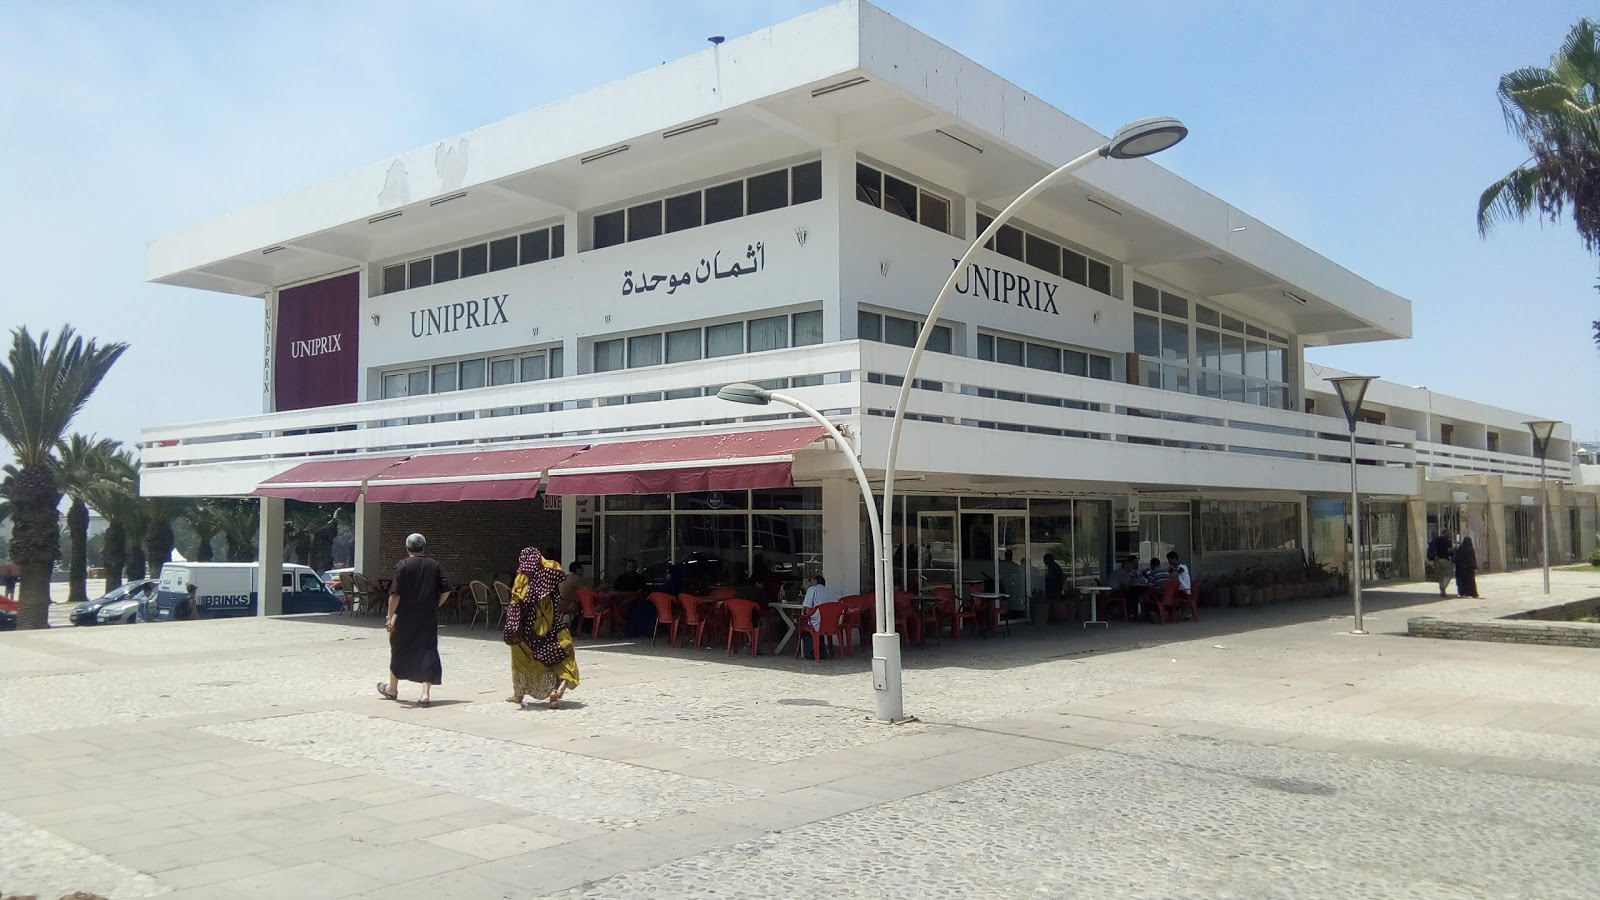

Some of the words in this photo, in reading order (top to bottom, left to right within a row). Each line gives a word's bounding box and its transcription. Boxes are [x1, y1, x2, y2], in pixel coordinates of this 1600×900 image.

[622, 270, 691, 296] موحدة
[695, 241, 765, 283] أثمان
[951, 258, 1060, 315] UNIPRIX
[410, 294, 510, 338] UNIPRIX
[263, 308, 272, 393] UNIPRIX
[291, 333, 342, 358] UNIPRIX
[205, 595, 249, 605] BRINKS
